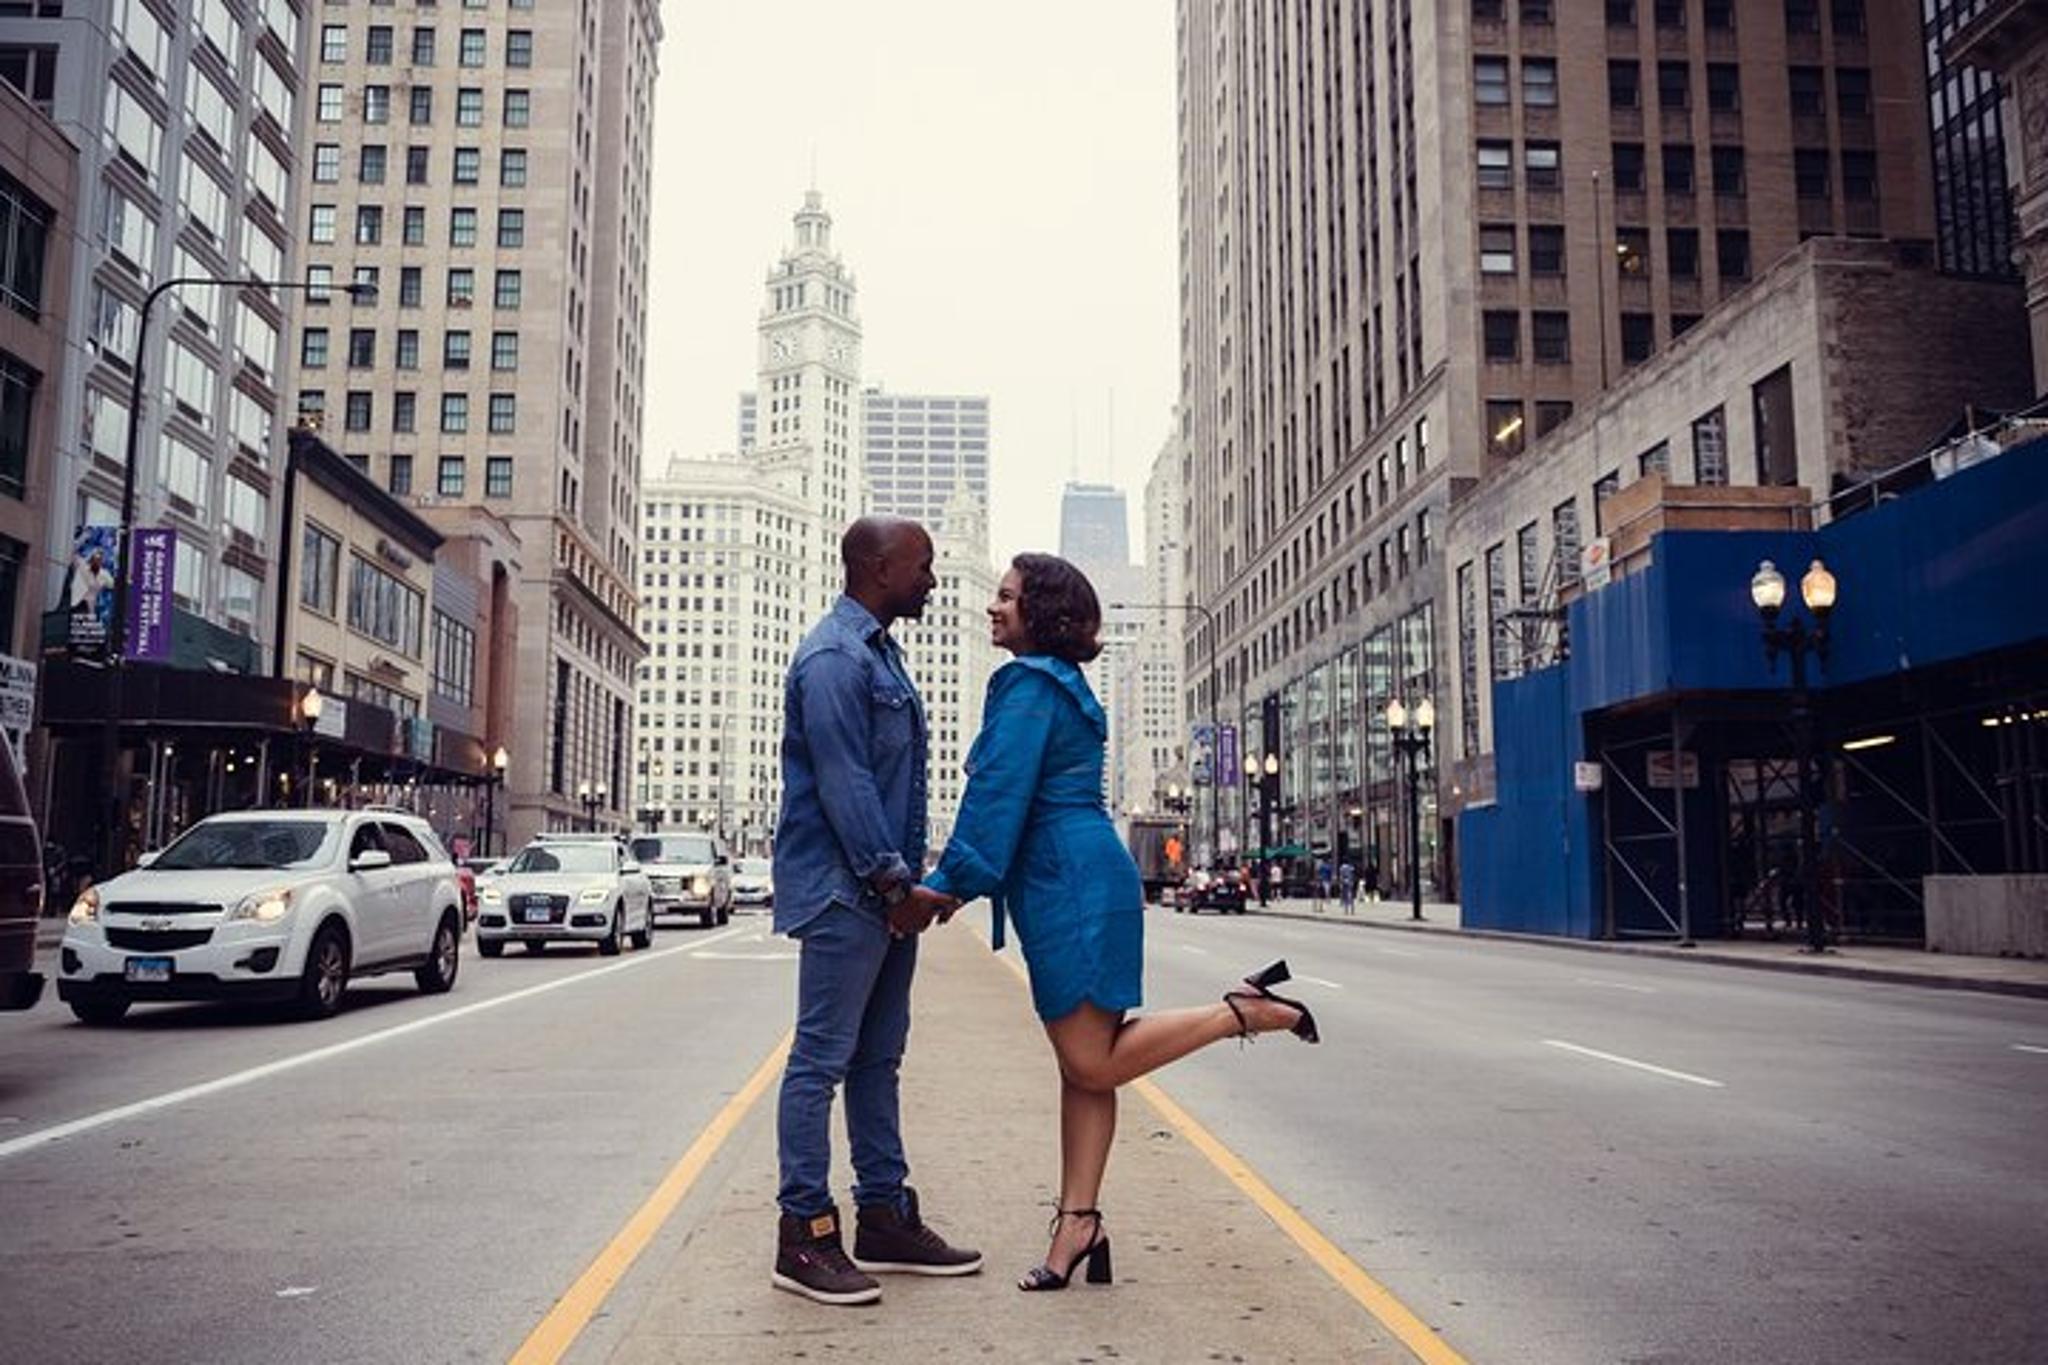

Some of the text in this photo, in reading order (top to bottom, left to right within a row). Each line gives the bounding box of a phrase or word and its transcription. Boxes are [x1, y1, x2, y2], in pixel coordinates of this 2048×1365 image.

[137, 551, 154, 656] MUSIC FESTIVAL
[153, 551, 165, 625] GRANT PARK
